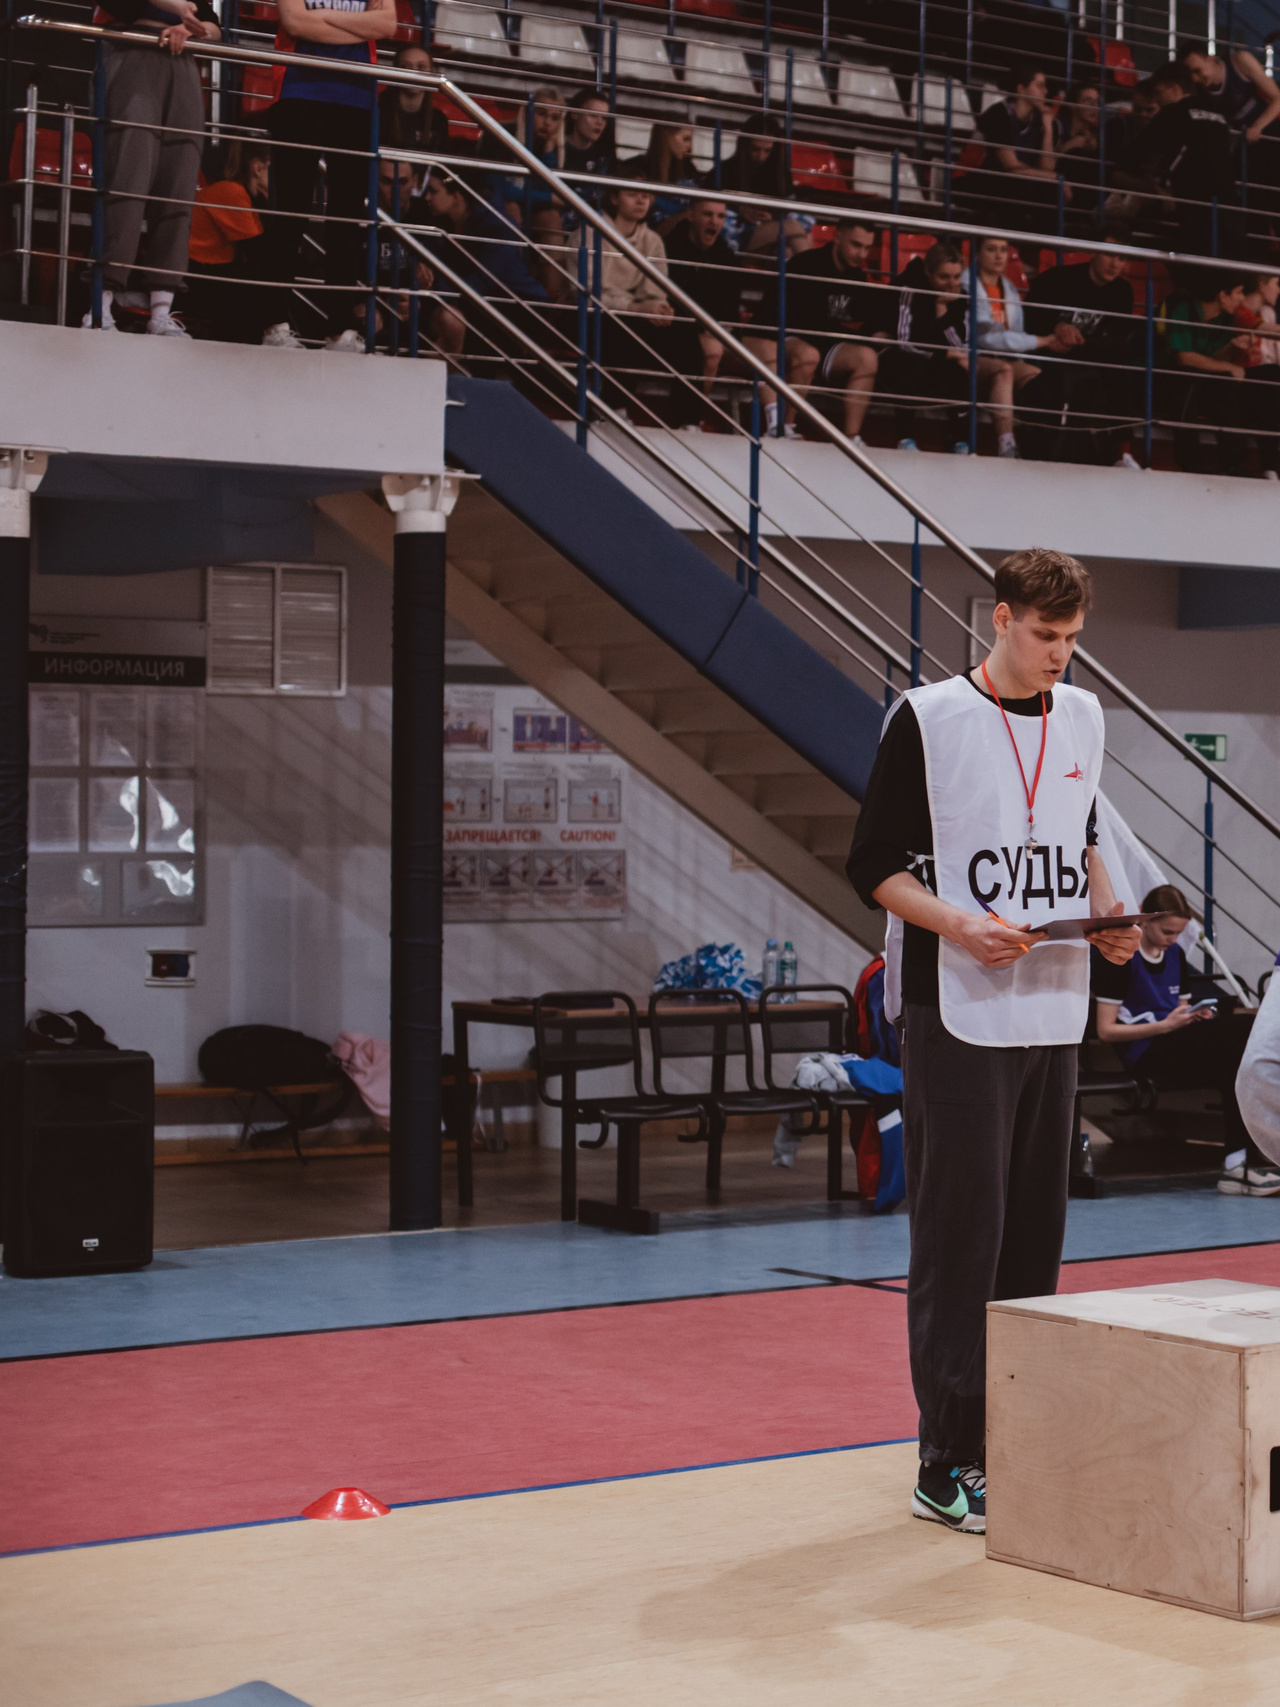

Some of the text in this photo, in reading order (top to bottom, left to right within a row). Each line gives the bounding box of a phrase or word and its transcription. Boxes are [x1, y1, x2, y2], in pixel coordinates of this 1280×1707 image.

[44, 658, 185, 681] ИНФОРМАЦИЯ
[445, 829, 542, 844] ЗАПРЕЩАЕТСЯ!
[559, 829, 616, 842] CAUTION!
